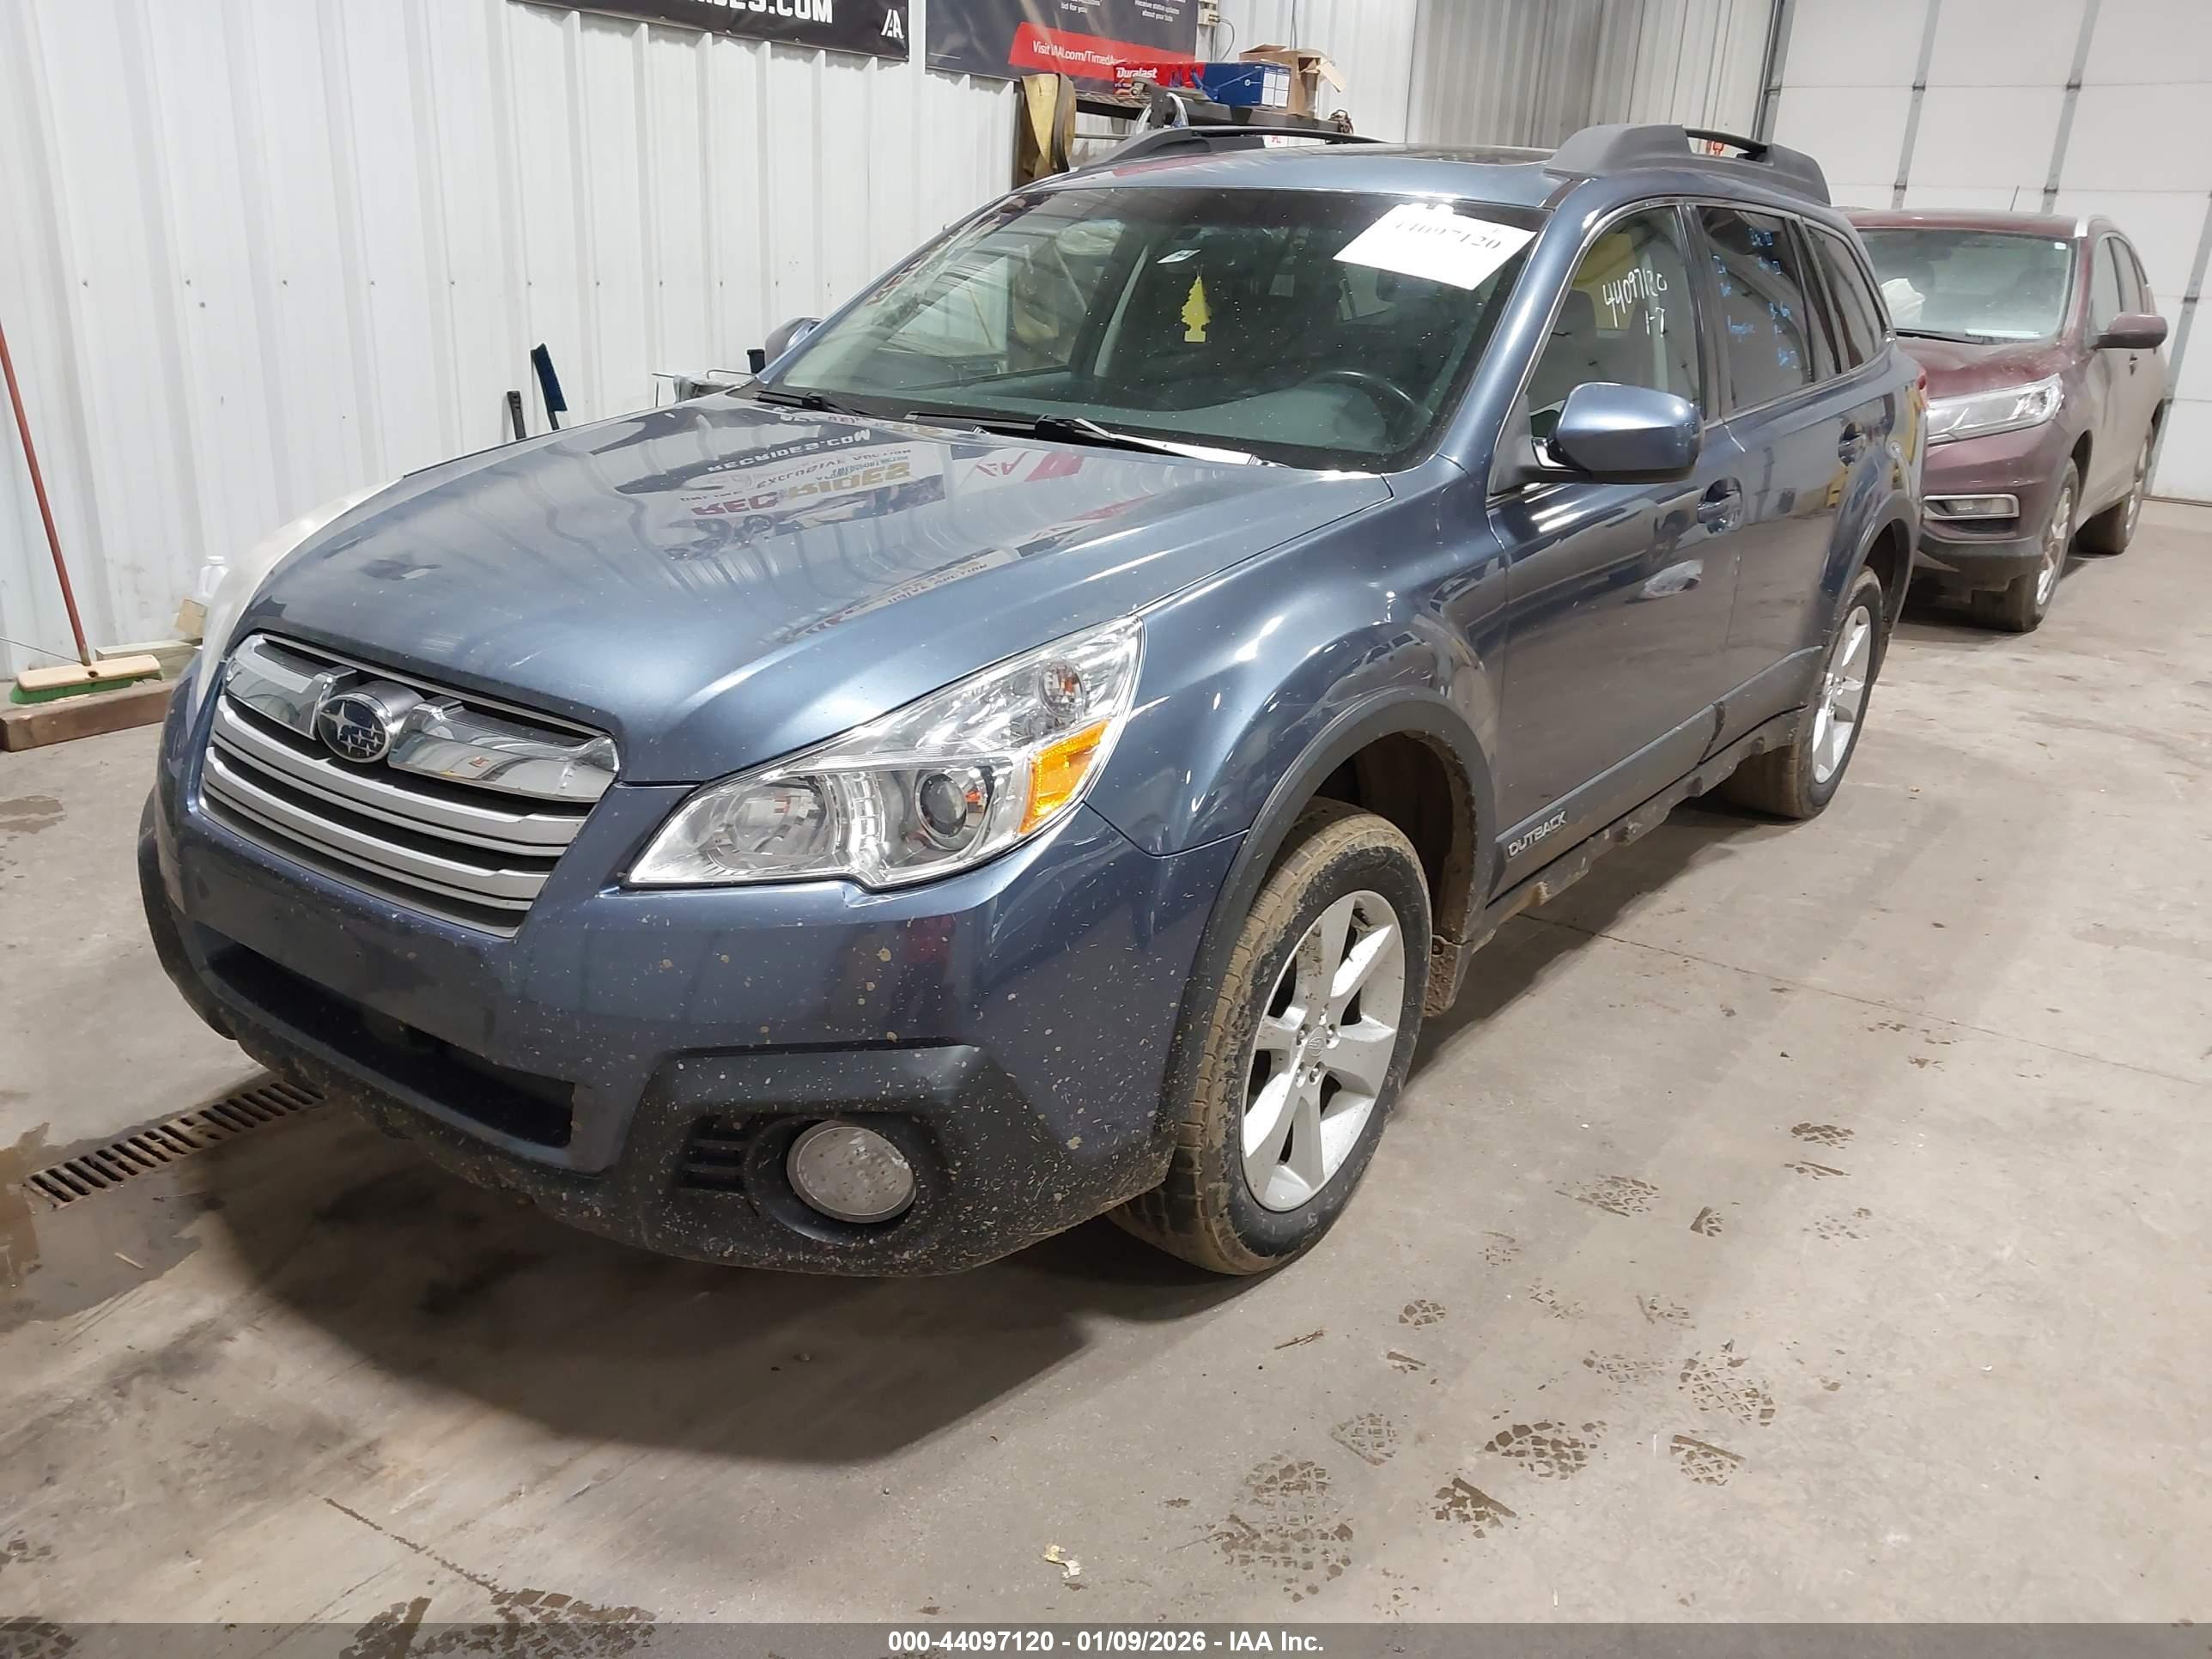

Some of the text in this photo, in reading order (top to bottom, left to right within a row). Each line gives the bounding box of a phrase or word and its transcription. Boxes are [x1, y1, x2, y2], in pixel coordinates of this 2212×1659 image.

[1033, 40, 1049, 55] Visit
[1115, 67, 1158, 79] Duralast
[1508, 811, 1566, 857] OUTBACK
